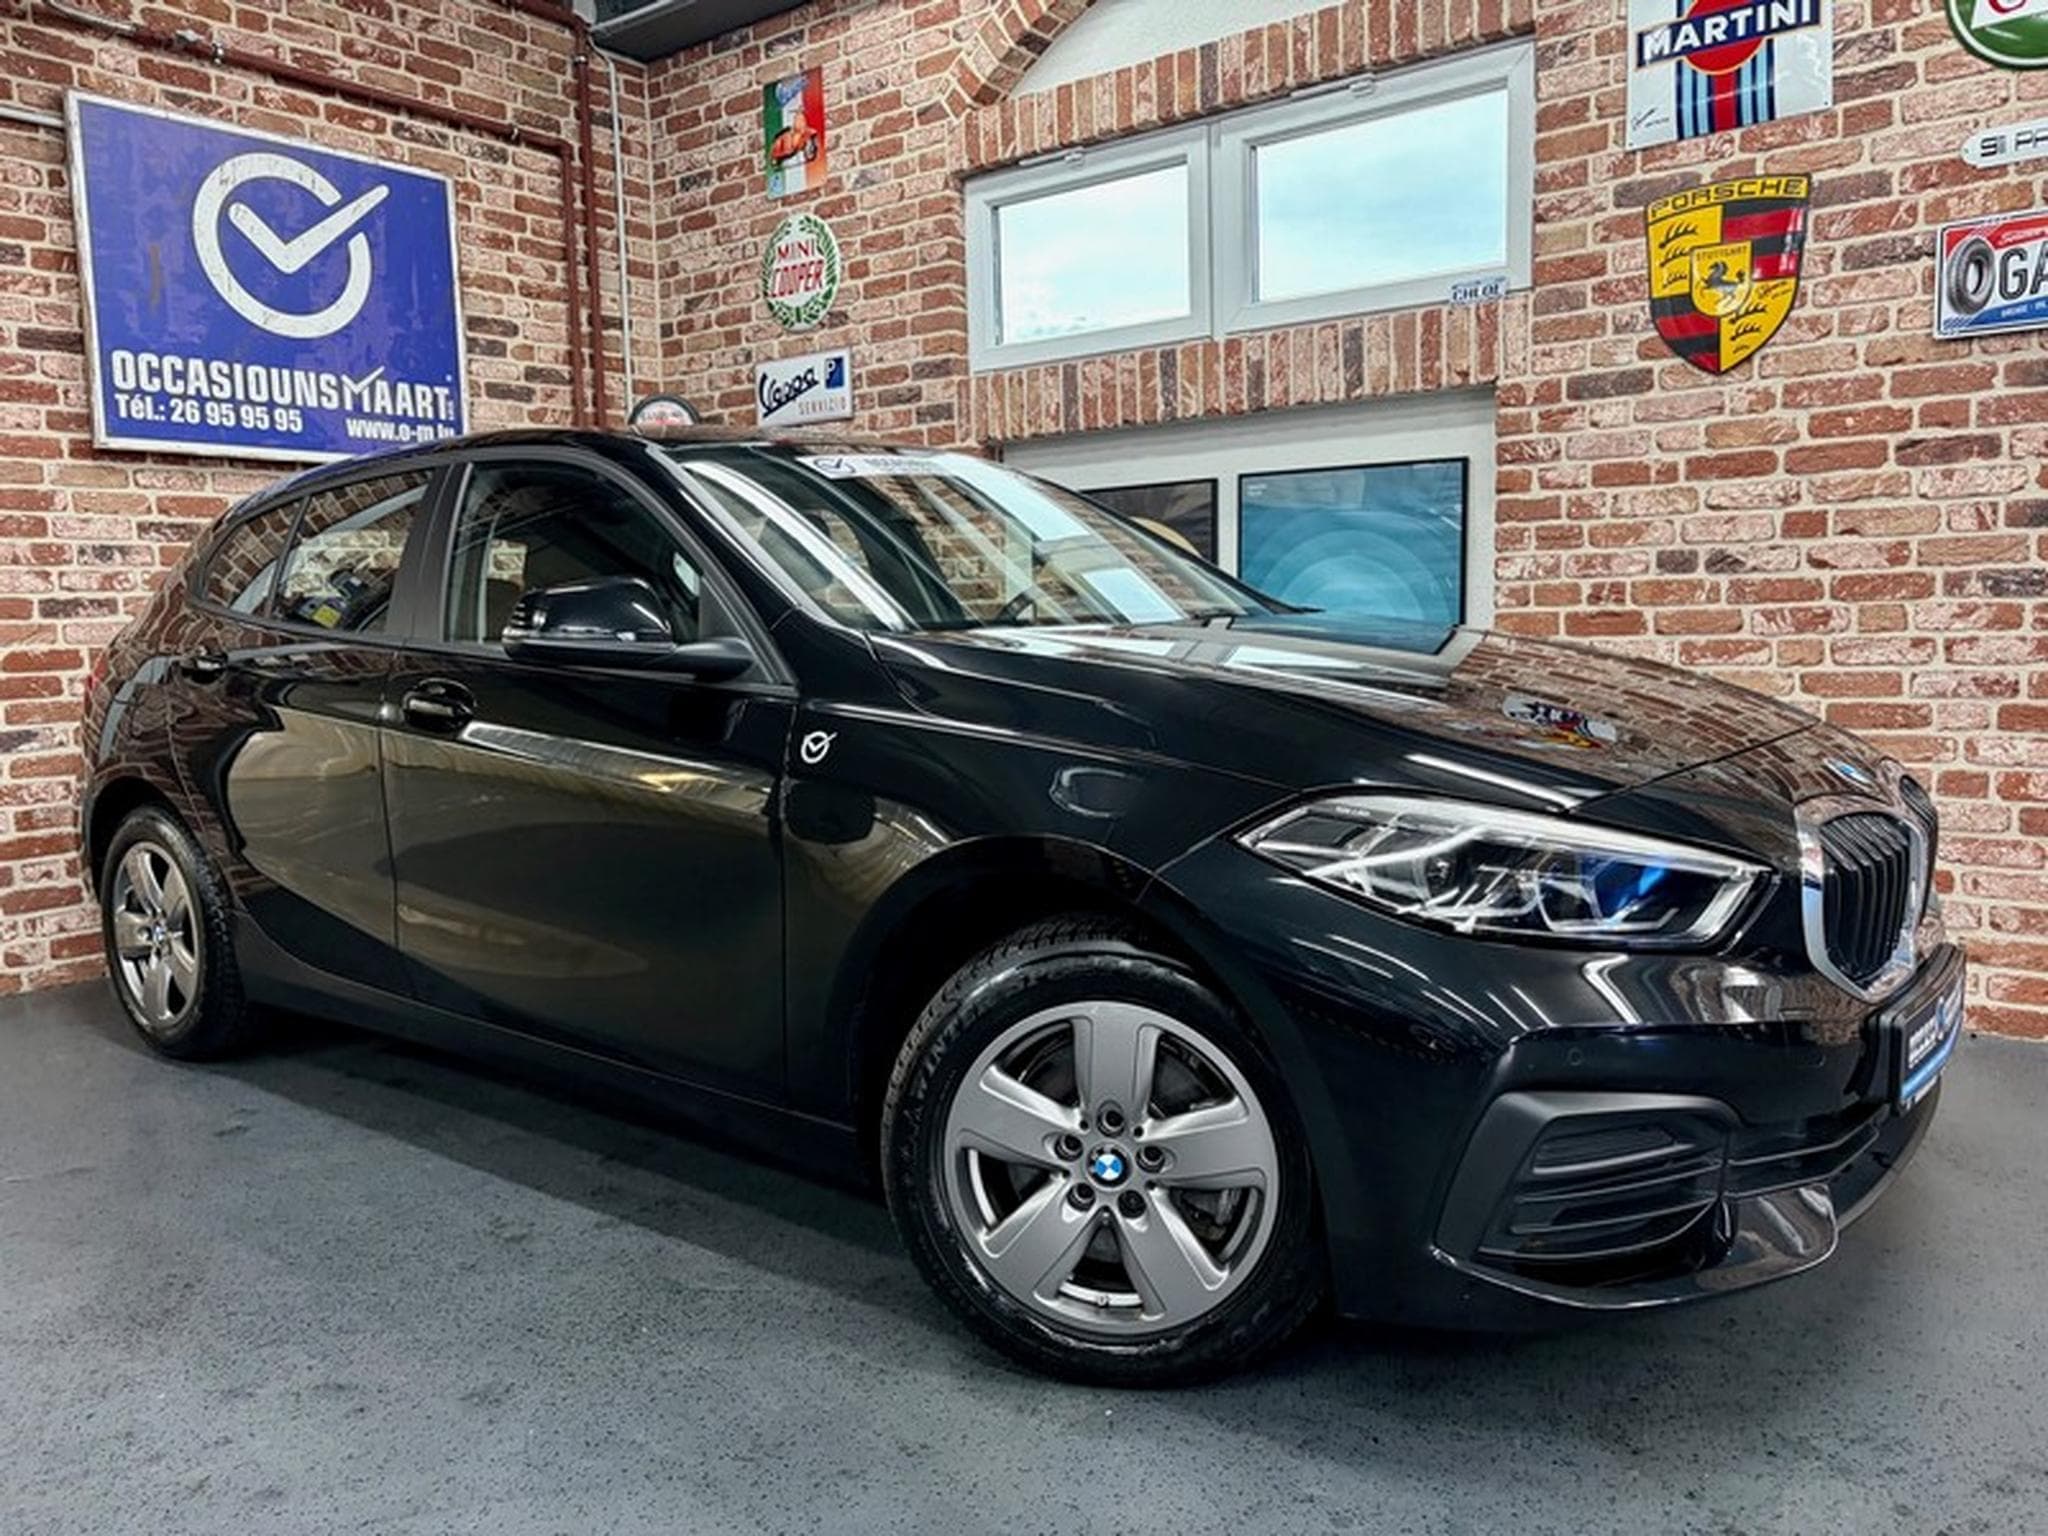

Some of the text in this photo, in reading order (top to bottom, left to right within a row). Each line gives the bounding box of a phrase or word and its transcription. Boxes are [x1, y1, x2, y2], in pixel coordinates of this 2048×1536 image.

[1643, 0, 1811, 63] MARTINI
[1651, 178, 1804, 217] PORSCHE
[777, 239, 815, 259] MINI
[771, 260, 824, 297] COOPER
[111, 349, 450, 421] OCCASIOUNSMAART
[759, 367, 819, 417] Vespa
[170, 398, 200, 424] 26
[205, 401, 236, 427] 95
[240, 404, 270, 430] 95
[273, 408, 304, 433] 95
[346, 418, 454, 442] www.o-mlu
